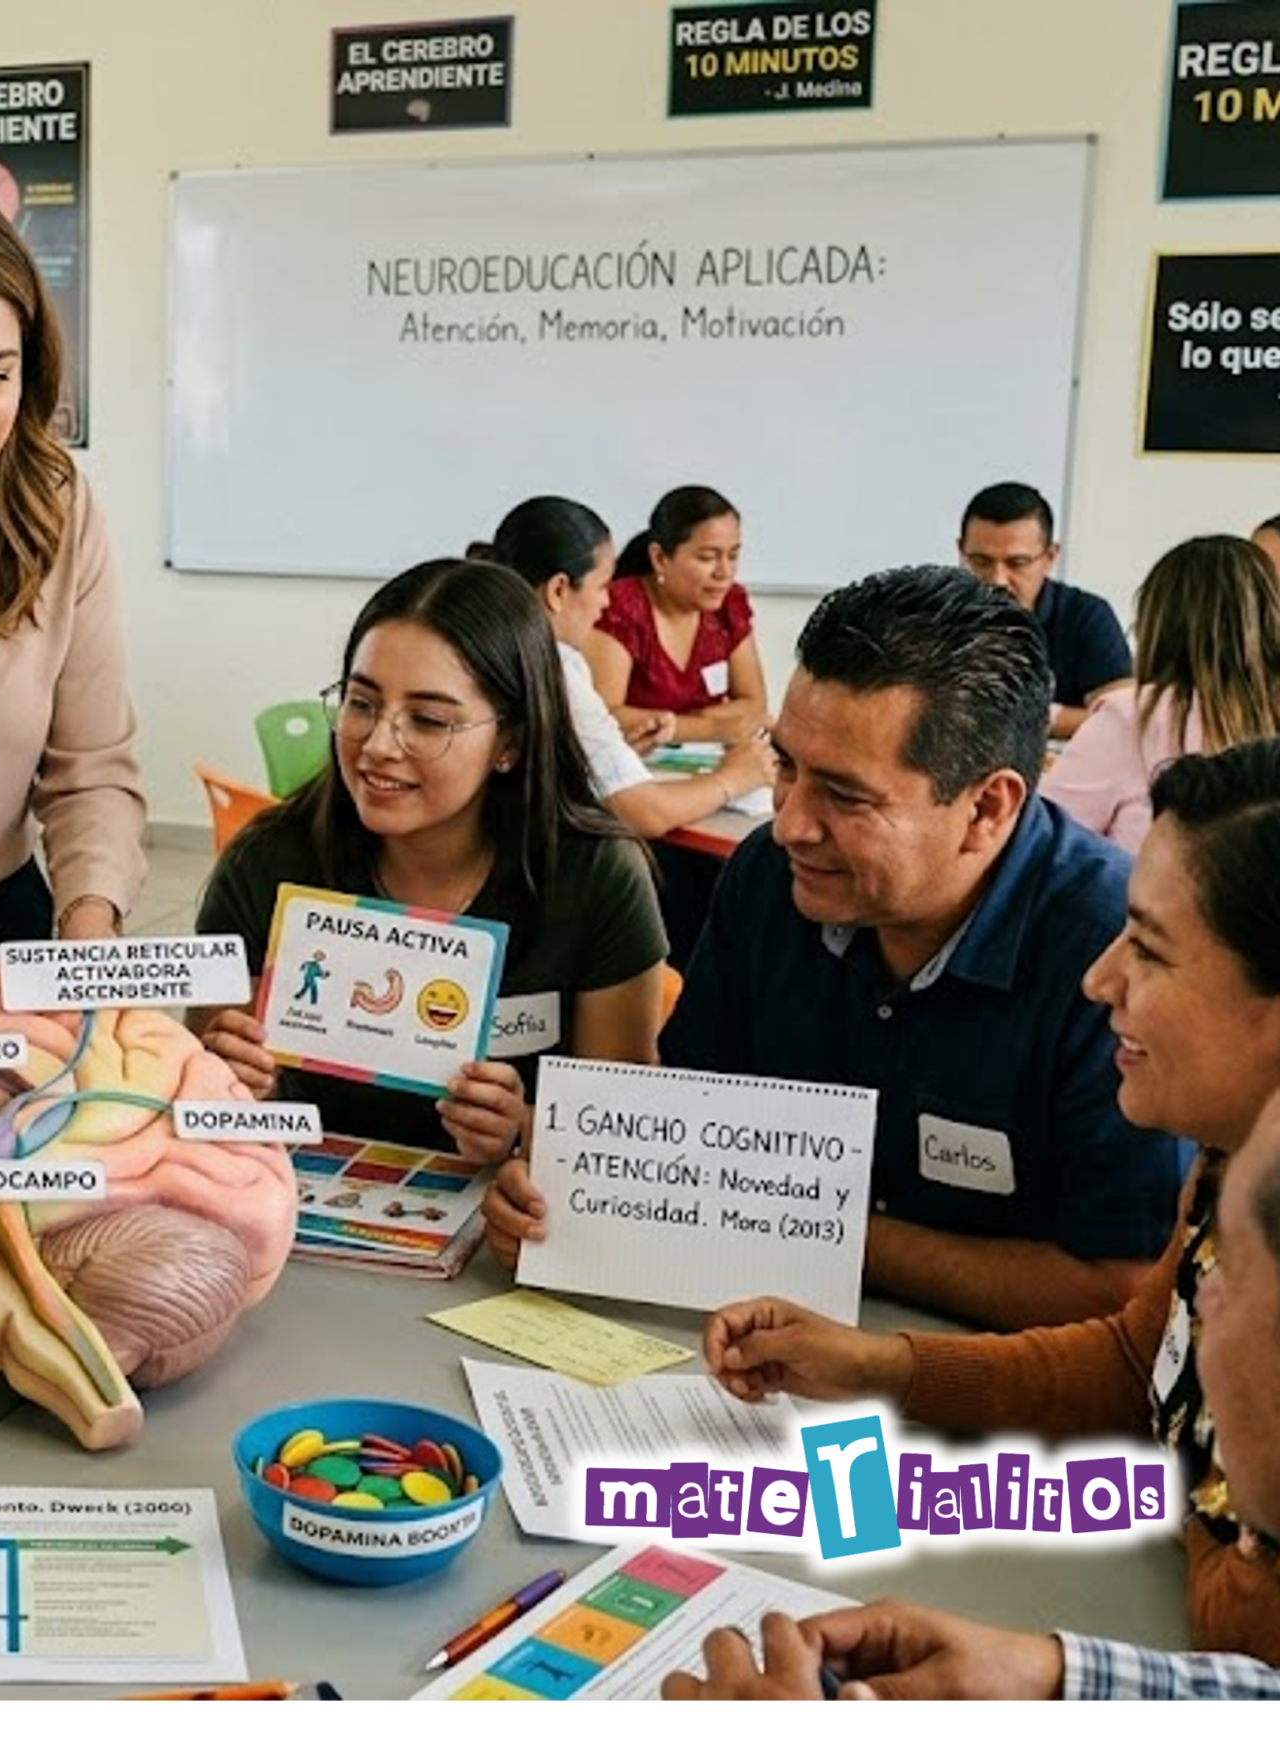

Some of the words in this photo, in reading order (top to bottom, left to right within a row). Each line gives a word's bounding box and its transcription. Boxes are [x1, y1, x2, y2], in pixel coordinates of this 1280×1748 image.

[675, 17, 766, 46] REGLA
[772, 14, 810, 40] DE
[815, 10, 871, 38] LOS
[348, 41, 377, 65] EL
[381, 33, 495, 64] CEREBRO
[685, 52, 719, 79] 10
[724, 43, 860, 77] MINUTOS
[336, 62, 505, 96] APRENDIENTE
[796, 79, 863, 99] Medina
[1193, 87, 1244, 123] 10
[366, 240, 677, 297] NEUROEDUCACIÓN
[696, 244, 887, 288] APLICADA:
[398, 311, 527, 345] Atención,
[538, 309, 667, 343] Memoria,
[680, 305, 846, 340] Motivación
[1167, 300, 1243, 332] Sólo
[1180, 339, 1213, 370] lo
[1220, 345, 1280, 376] que
[6, 944, 122, 966] SUSTANCIA
[127, 941, 239, 961] RETICULAR
[305, 911, 380, 942] PAUSA
[385, 926, 471, 960] ACTIVA
[183, 1109, 313, 1133] DOPAMINA
[577, 1105, 687, 1146] GANCHO
[699, 1121, 846, 1163] COGNITIVO
[924, 1133, 997, 1173] Carlos
[572, 1151, 711, 1189] ATENCIÓN:
[720, 1167, 821, 1201] Novedad
[835, 1186, 850, 1211] y
[569, 1187, 709, 1229] Curiosidad.
[720, 1208, 771, 1235] Mora
[778, 1213, 846, 1246] (2013)
[289, 1515, 403, 1548] DOPAMINA
